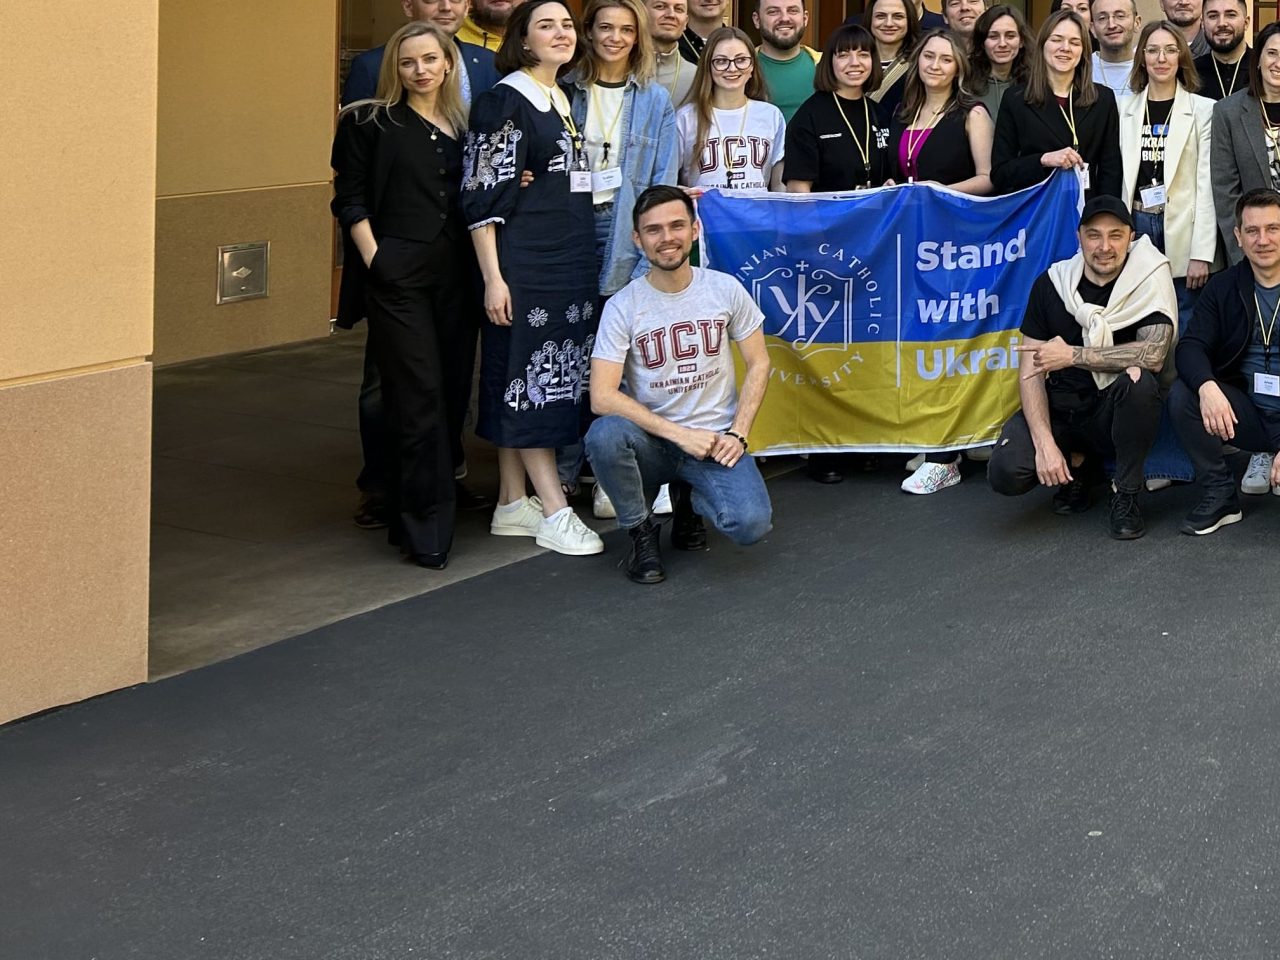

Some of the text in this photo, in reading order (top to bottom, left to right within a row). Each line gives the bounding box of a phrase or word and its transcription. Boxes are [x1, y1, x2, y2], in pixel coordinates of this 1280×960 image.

[916, 228, 1027, 272] Stand
[736, 243, 882, 335] INIAN CATHOLIC
[916, 288, 1000, 324] with
[635, 319, 727, 370] UCU
[916, 337, 1020, 381] Ukrai
[649, 376, 690, 389] UKRAINIAN
